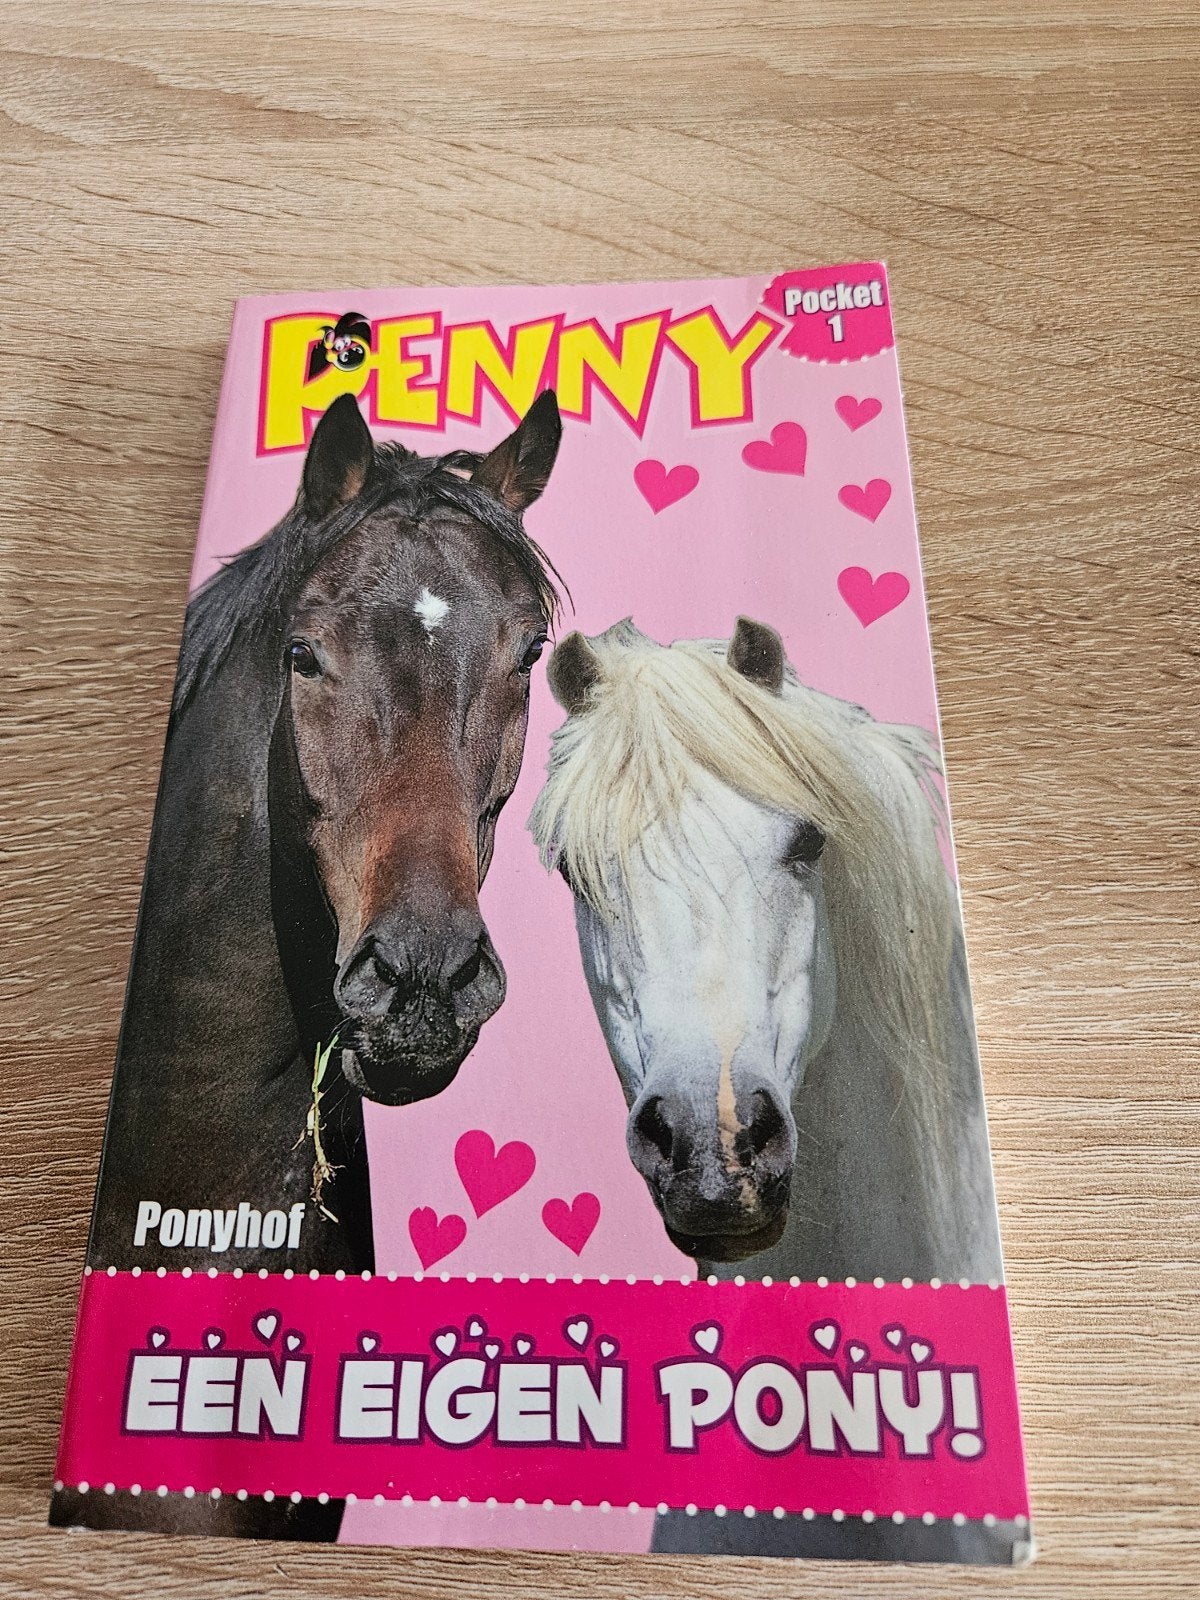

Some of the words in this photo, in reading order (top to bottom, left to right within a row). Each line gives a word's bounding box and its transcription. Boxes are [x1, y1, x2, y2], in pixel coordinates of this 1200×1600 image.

[784, 280, 884, 316] Pocket
[827, 313, 844, 343] 1
[256, 305, 785, 457] PENNY
[134, 1200, 306, 1253] Ponyhof
[123, 1350, 306, 1439] EEN
[336, 1353, 625, 1446] EIGEN
[657, 1357, 984, 1460] PONY!
